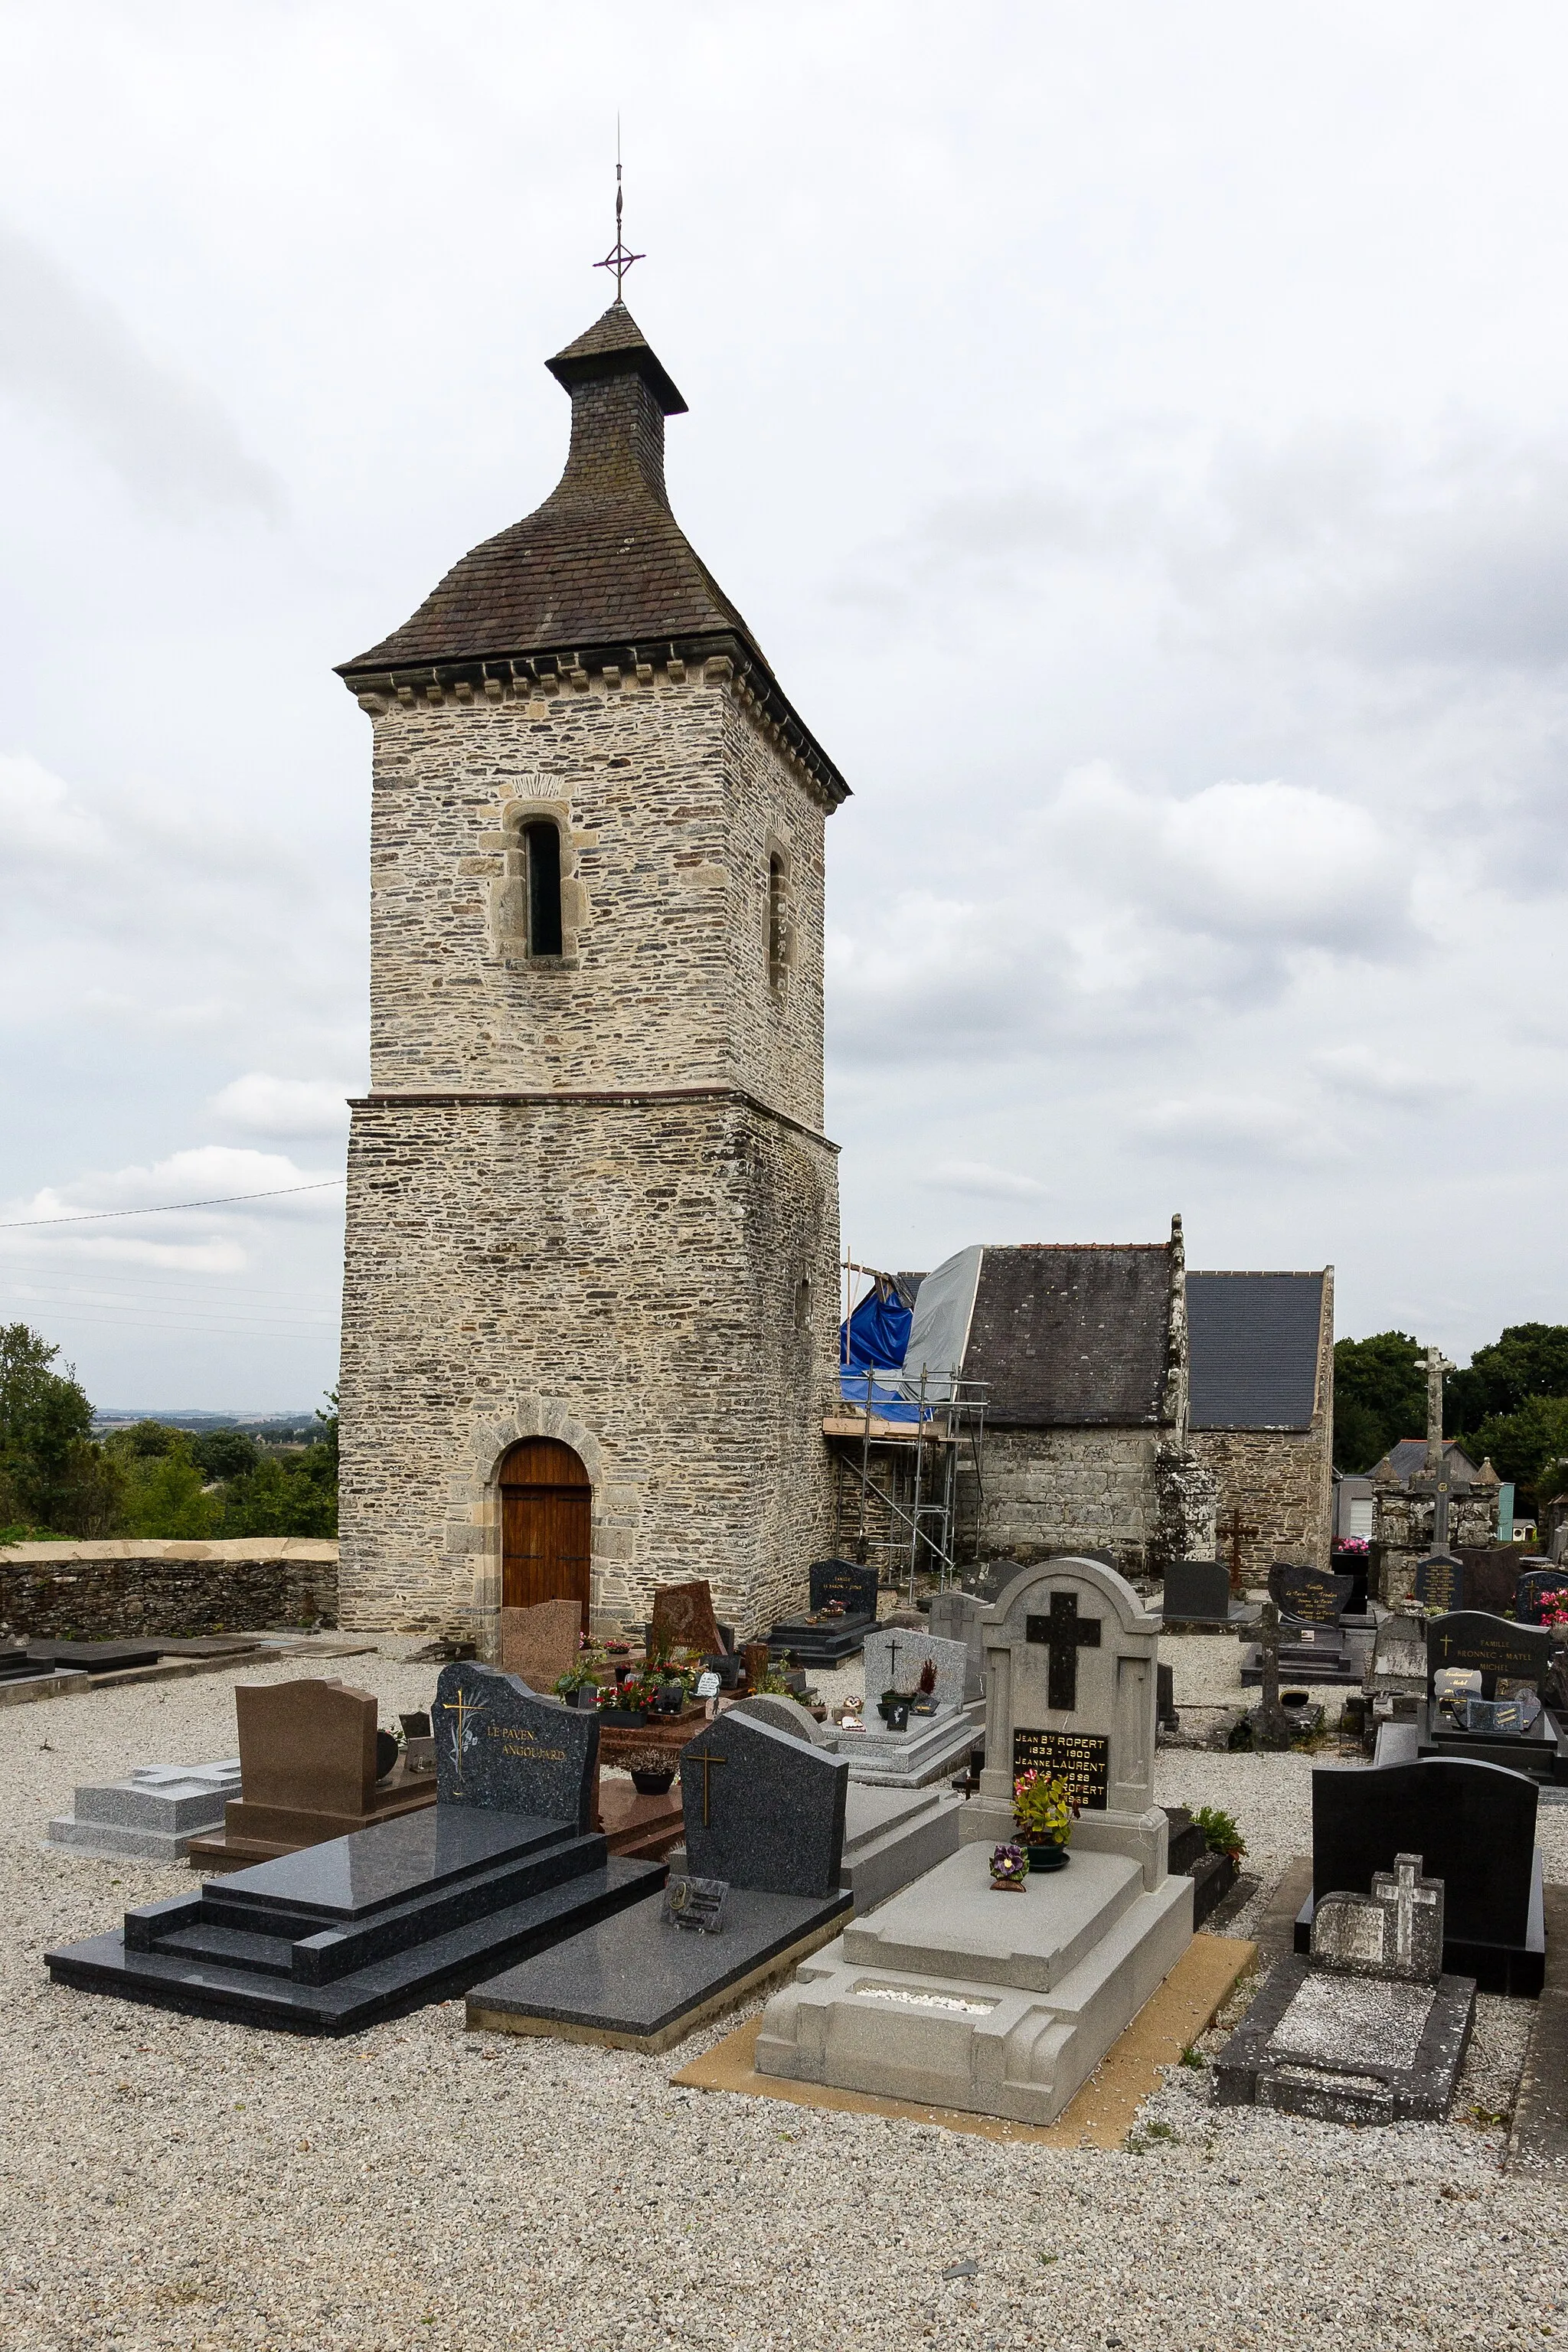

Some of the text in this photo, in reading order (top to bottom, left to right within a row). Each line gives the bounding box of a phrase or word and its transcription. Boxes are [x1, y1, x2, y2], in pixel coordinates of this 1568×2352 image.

[1481, 1639, 1510, 1648] FAMILLE
[1479, 1663, 1509, 1672] MICHEL
[487, 1726, 500, 1737] LE
[1015, 1733, 1038, 1743] JEAN
[1057, 1736, 1105, 1749] ROPERT
[1029, 1746, 1053, 1756] 1833
[1066, 1749, 1090, 1759] 1900
[1014, 1756, 1106, 1772] JEANNE LAURENT
[1062, 1782, 1105, 1795] ROPERT
